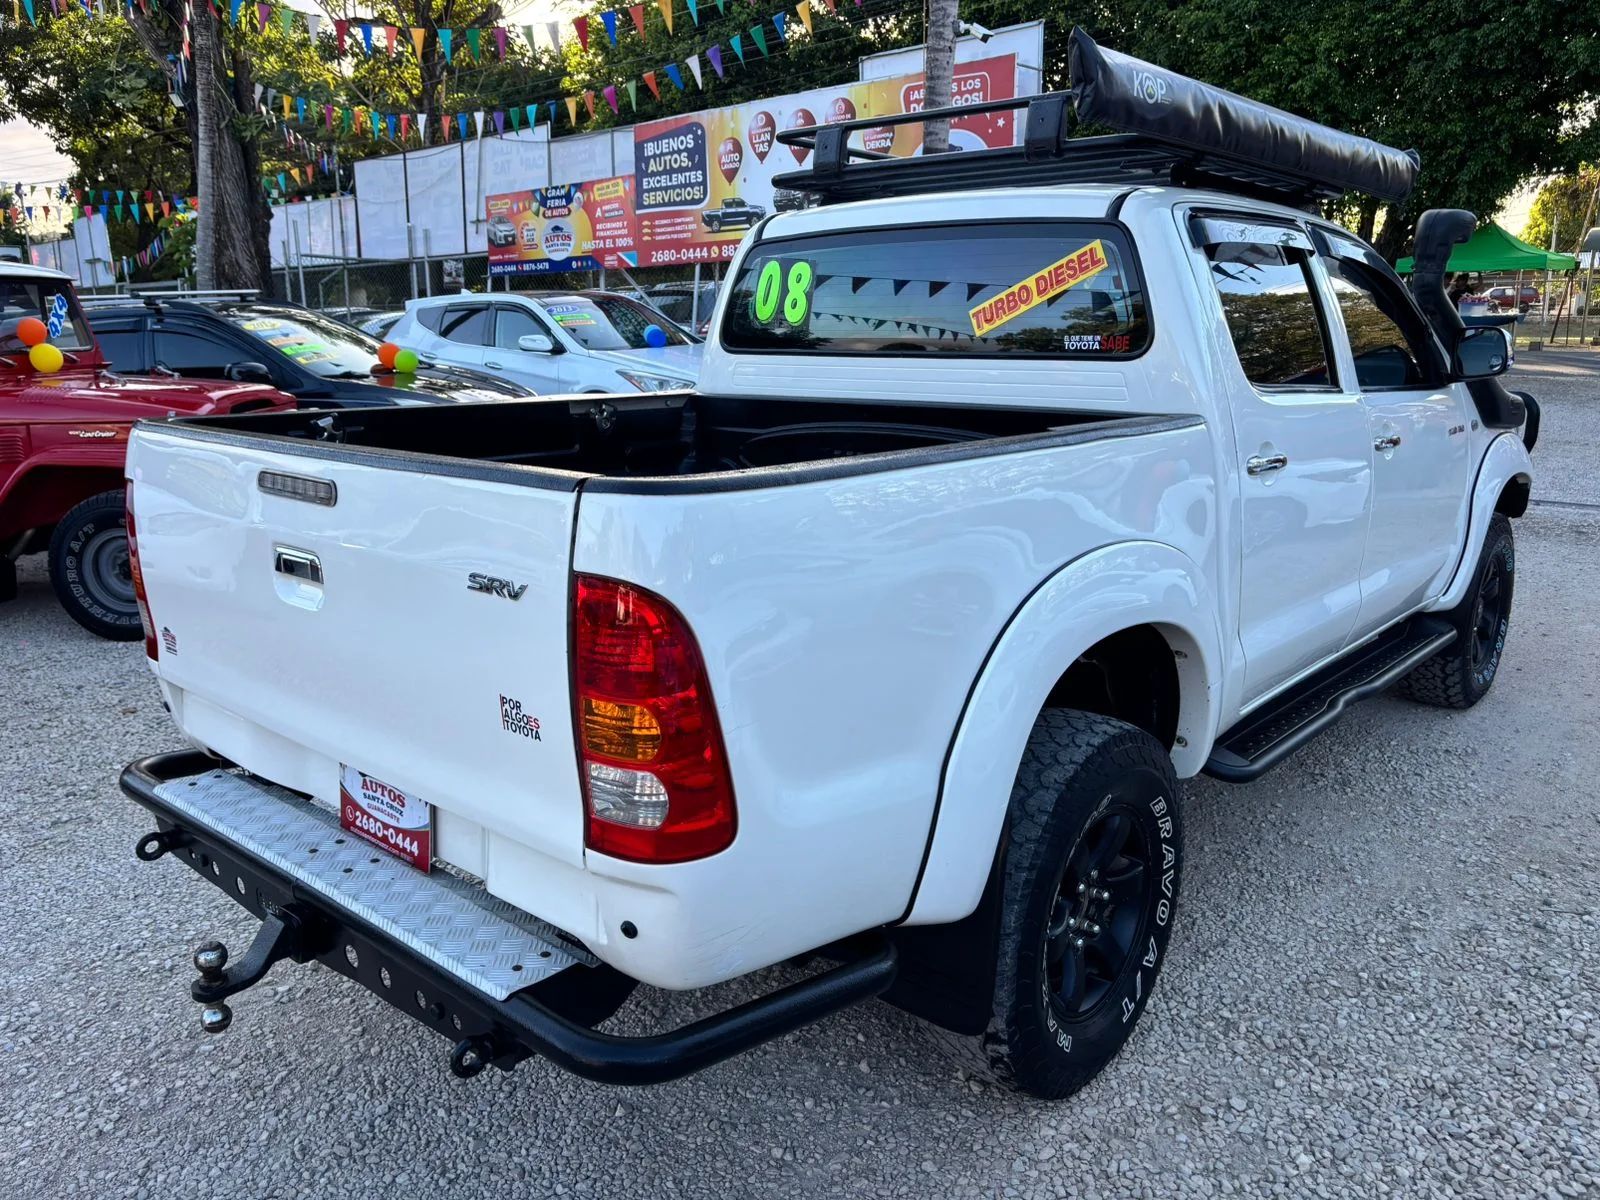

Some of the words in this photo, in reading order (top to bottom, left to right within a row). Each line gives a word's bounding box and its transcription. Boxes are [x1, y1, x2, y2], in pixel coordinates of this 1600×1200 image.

[961, 78, 981, 91] LOS
[644, 134, 694, 157] ¡BUENOS
[752, 133, 770, 143] LLAN
[866, 138, 892, 150] DEKRA
[754, 143, 769, 153] TAS
[648, 152, 692, 174] AUTOS,
[721, 152, 740, 163] AUTO
[642, 170, 703, 189] EXCELENTES
[547, 189, 566, 197] GRAN
[642, 186, 704, 206] SERVICIOS!
[546, 198, 567, 208] FERIA
[595, 207, 602, 217] A
[544, 234, 572, 244] AUTOS
[581, 239, 605, 250] HASTA
[605, 239, 614, 248] EL
[615, 237, 634, 247] 100%
[651, 247, 708, 262] 2680-0444
[755, 260, 812, 326] 08
[972, 284, 1033, 330] TURBO
[1034, 246, 1105, 298] DIESEL
[1064, 341, 1100, 350] TOYOTA
[1101, 335, 1130, 351] SABE
[467, 571, 528, 601] SRV
[501, 696, 522, 713] POR
[504, 719, 541, 742] TOYOTA
[361, 777, 406, 809] AUTOS
[363, 792, 385, 806] SANTA
[386, 801, 404, 817] CRUZ
[355, 810, 419, 857] 2680-0444
[1150, 796, 1175, 926] BRAVO
